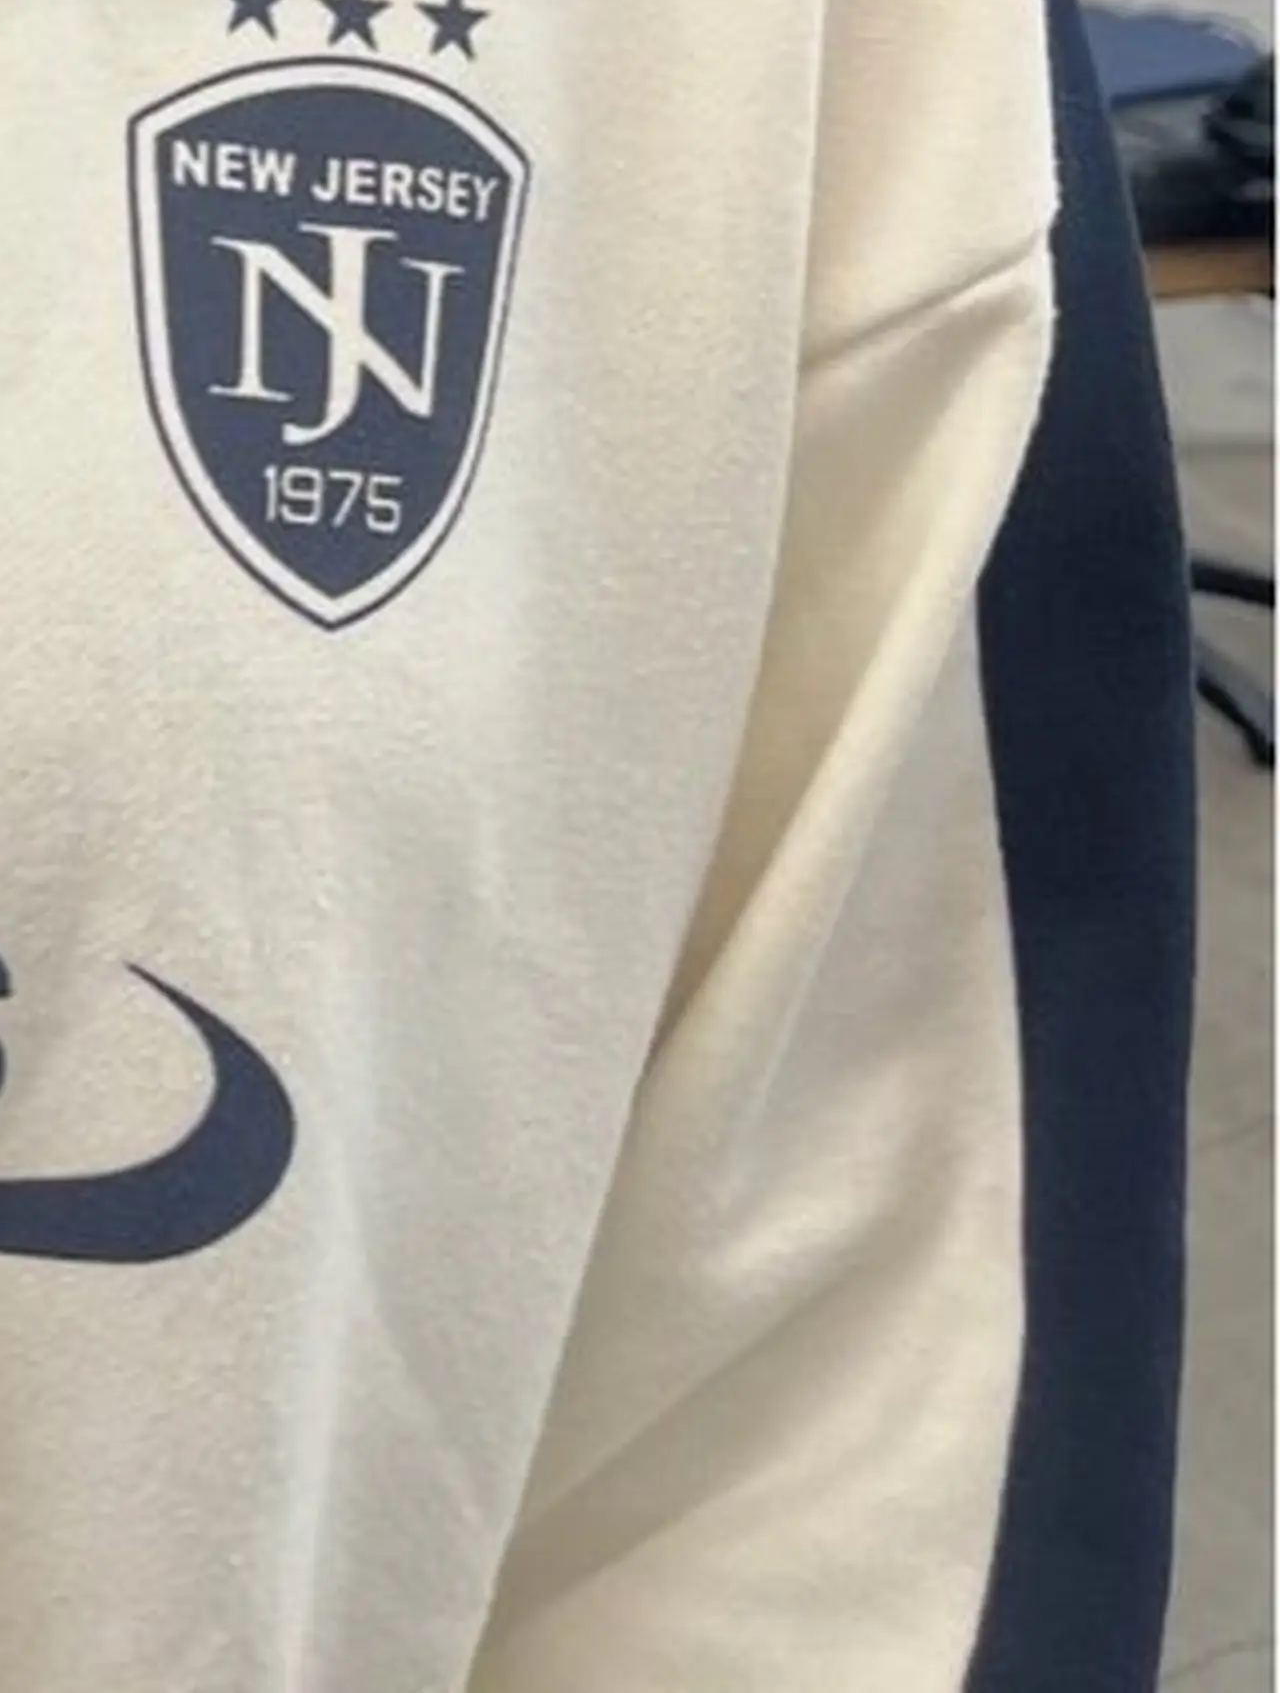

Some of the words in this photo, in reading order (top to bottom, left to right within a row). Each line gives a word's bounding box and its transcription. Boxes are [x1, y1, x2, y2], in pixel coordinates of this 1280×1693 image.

[172, 139, 297, 197] NEW
[310, 157, 499, 221] JERSEY
[263, 464, 403, 534] 1975
